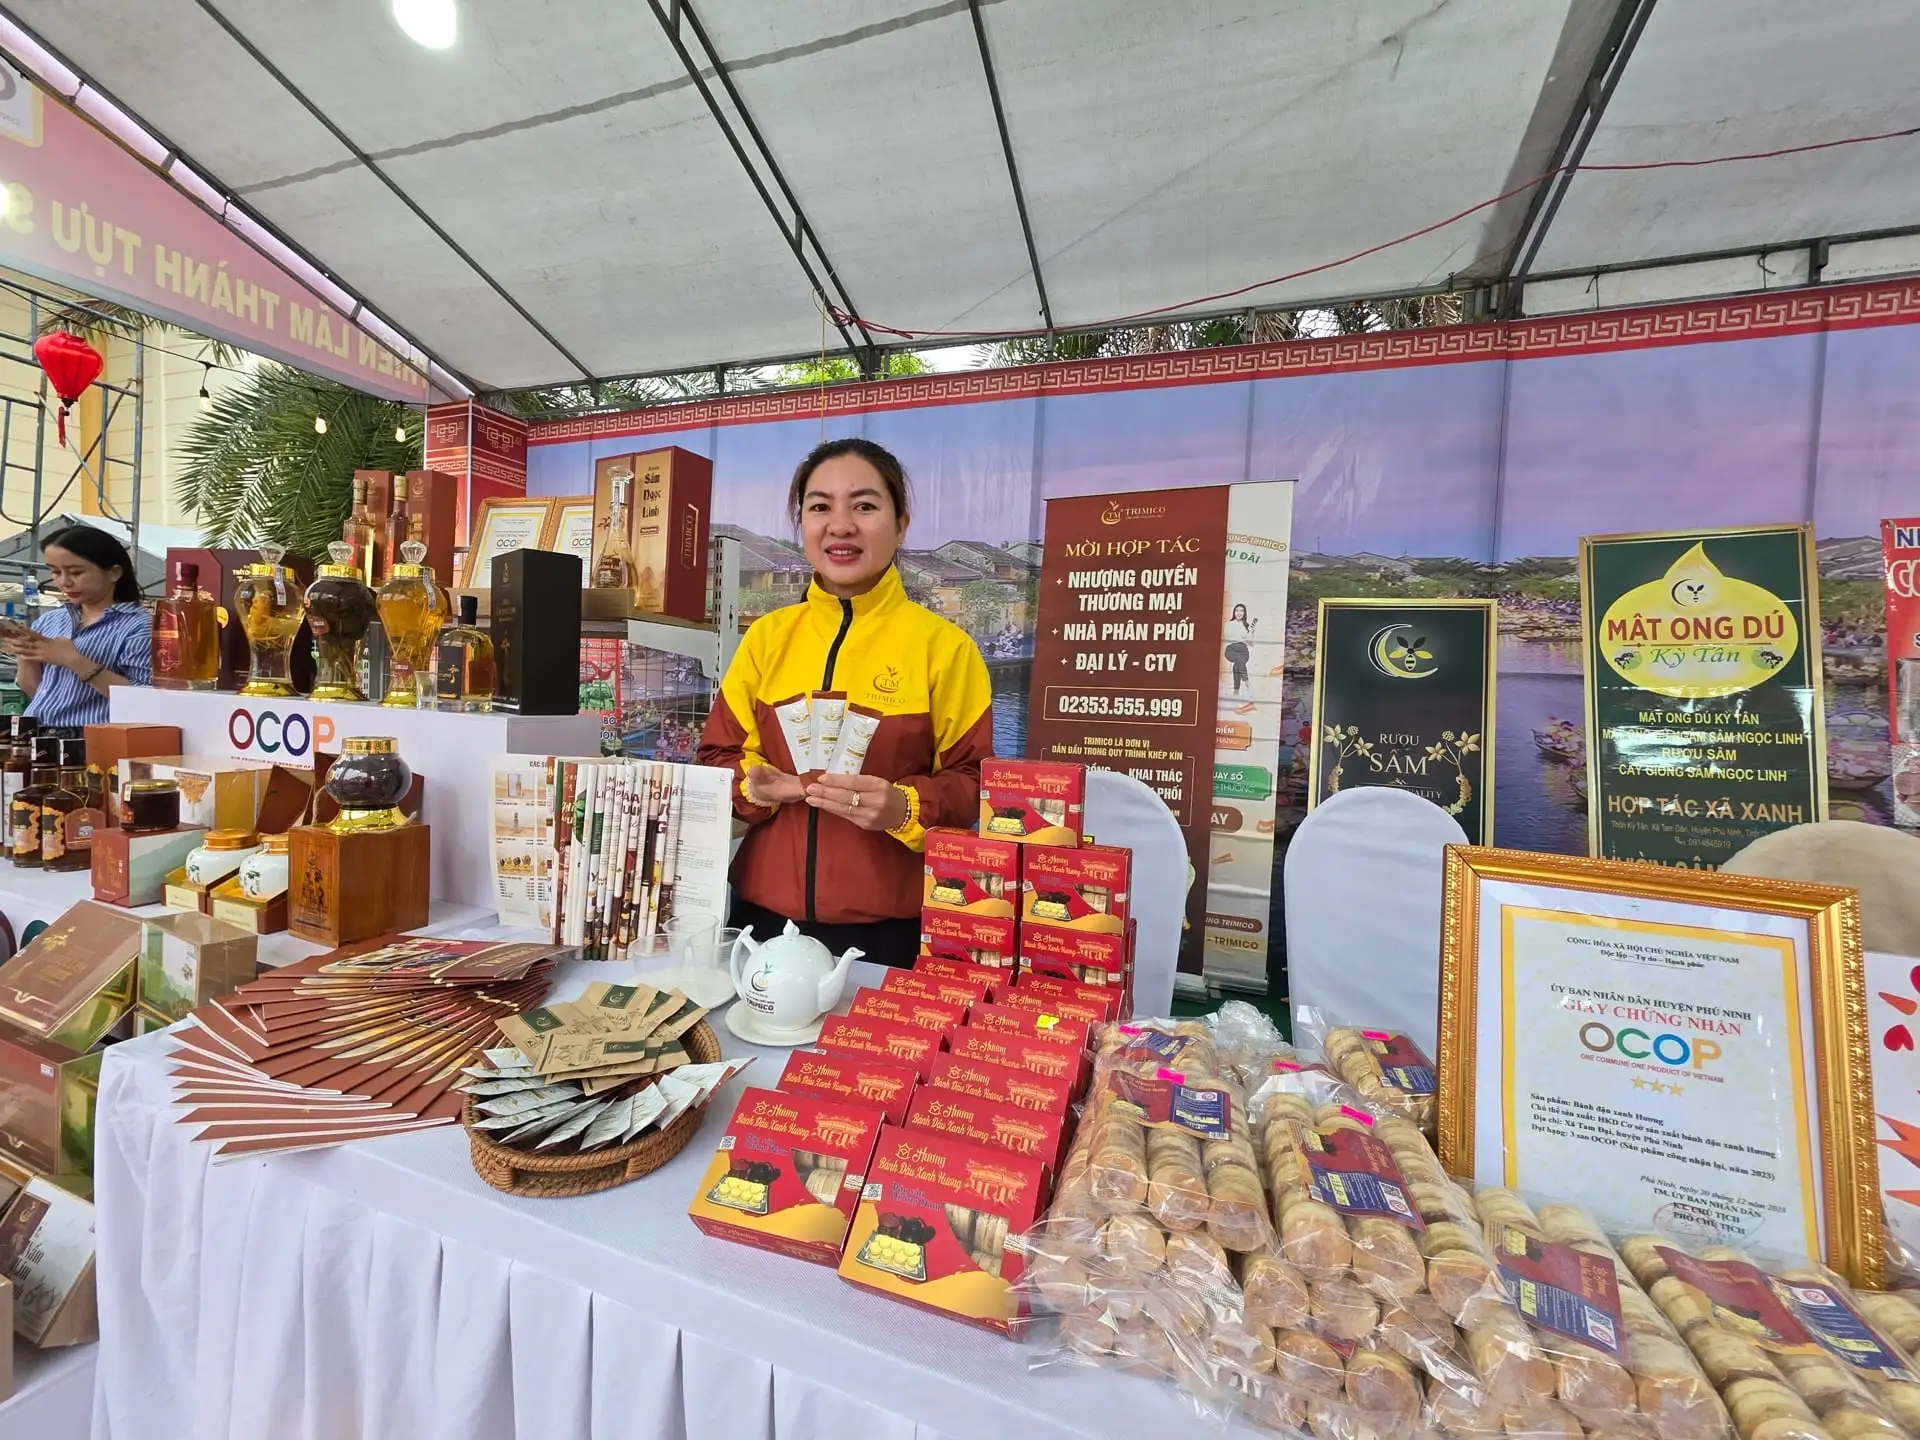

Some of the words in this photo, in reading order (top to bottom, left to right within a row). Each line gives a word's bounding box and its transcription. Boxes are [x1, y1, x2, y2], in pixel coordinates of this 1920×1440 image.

[1125, 506, 1166, 516] TRIMICO
[1065, 539, 1101, 557] MỜI
[1107, 539, 1150, 558] HỢP
[1156, 536, 1200, 554] TÁC
[1240, 552, 1260, 563] ĐÃI
[1068, 569, 1136, 591] NHƯỢNG
[1079, 593, 1144, 612] THƯƠNG
[1149, 593, 1183, 617] MẠI
[1064, 620, 1097, 641] NHÀ
[1102, 619, 1148, 641] PHÂN
[1153, 617, 1195, 641] PHỐI
[1670, 616, 1734, 641] ONG
[1743, 609, 1784, 639] DÚ
[1075, 653, 1103, 675] ĐẠI
[1108, 650, 1128, 671] LÝ
[1144, 654, 1177, 672] CTV
[1650, 648, 1686, 669] Kỳ
[1693, 646, 1741, 663] Tân
[1059, 695, 1183, 717] 02353.555.999
[1666, 713, 1692, 723] ONG
[1695, 710, 1711, 724] DÚ
[1715, 711, 1731, 724] KỲ
[1734, 711, 1760, 725] TÂN
[229, 708, 336, 757] OCOP
[1084, 737, 1113, 746] TRIMICO
[1114, 736, 1123, 747] LÀ
[1125, 738, 1141, 748] ĐƠN
[1142, 740, 1150, 749] VỊ
[1379, 732, 1420, 750] RƯỢU
[1737, 732, 1772, 746] NGỌC
[1776, 733, 1803, 744] LINH
[1084, 747, 1107, 756] TRONG
[1109, 748, 1123, 757] QUY
[1125, 748, 1146, 758] TRÌNH
[1148, 749, 1167, 760] KHÉP
[1169, 750, 1183, 761] KÍN
[1369, 748, 1428, 776] SÂM
[1707, 747, 1737, 760] SÂM
[1129, 768, 1153, 780] KHAI
[1156, 768, 1183, 782] THÁC
[1231, 771, 1243, 781] SỐ
[1718, 768, 1753, 782] NGỌC
[1758, 770, 1786, 781] LINH
[1158, 784, 1182, 800] PHỐI
[1608, 795, 1651, 818] HỢP
[1657, 794, 1698, 818] TÁC
[1705, 797, 1734, 820] XÃ
[1741, 803, 1802, 823] XANH
[1222, 919, 1254, 929] TRIMICO
[1214, 936, 1258, 949] TRIMICO
[1626, 944, 1642, 953] HỘI
[1665, 948, 1693, 958] NGHĨA
[1696, 952, 1718, 963] VIỆT
[1719, 955, 1740, 964] NAM
[1568, 987, 1591, 997] BAN
[1593, 990, 1625, 1002] NHÂN
[1627, 995, 1650, 1006] DÂN
[1653, 999, 1693, 1013] HUYỆN
[1696, 1004, 1720, 1016] PHÚ
[1722, 1010, 1751, 1021] NINH
[1613, 1005, 1682, 1027] CHỨNG
[1687, 1016, 1742, 1036] NHẬN
[1579, 1022, 1722, 1070] OCOP
[1580, 1053, 1595, 1061] ONE
[1595, 1055, 1630, 1067] COMMUNE
[1631, 1061, 1646, 1070] ONE
[1647, 1064, 1681, 1076] PRODUCT
[1681, 1070, 1691, 1078] OF
[1692, 1072, 1724, 1083] VIETNAM
[1591, 1136, 1618, 1146] OCOP
[912, 1146, 947, 1169] Hương
[878, 1156, 899, 1172] Bánh
[915, 1166, 937, 1183] Xanh
[938, 1171, 962, 1193] Hương
[1687, 1195, 1708, 1206] BAN
[1709, 1199, 1739, 1213] NHÂN
[1740, 1206, 1762, 1218] DÂN
